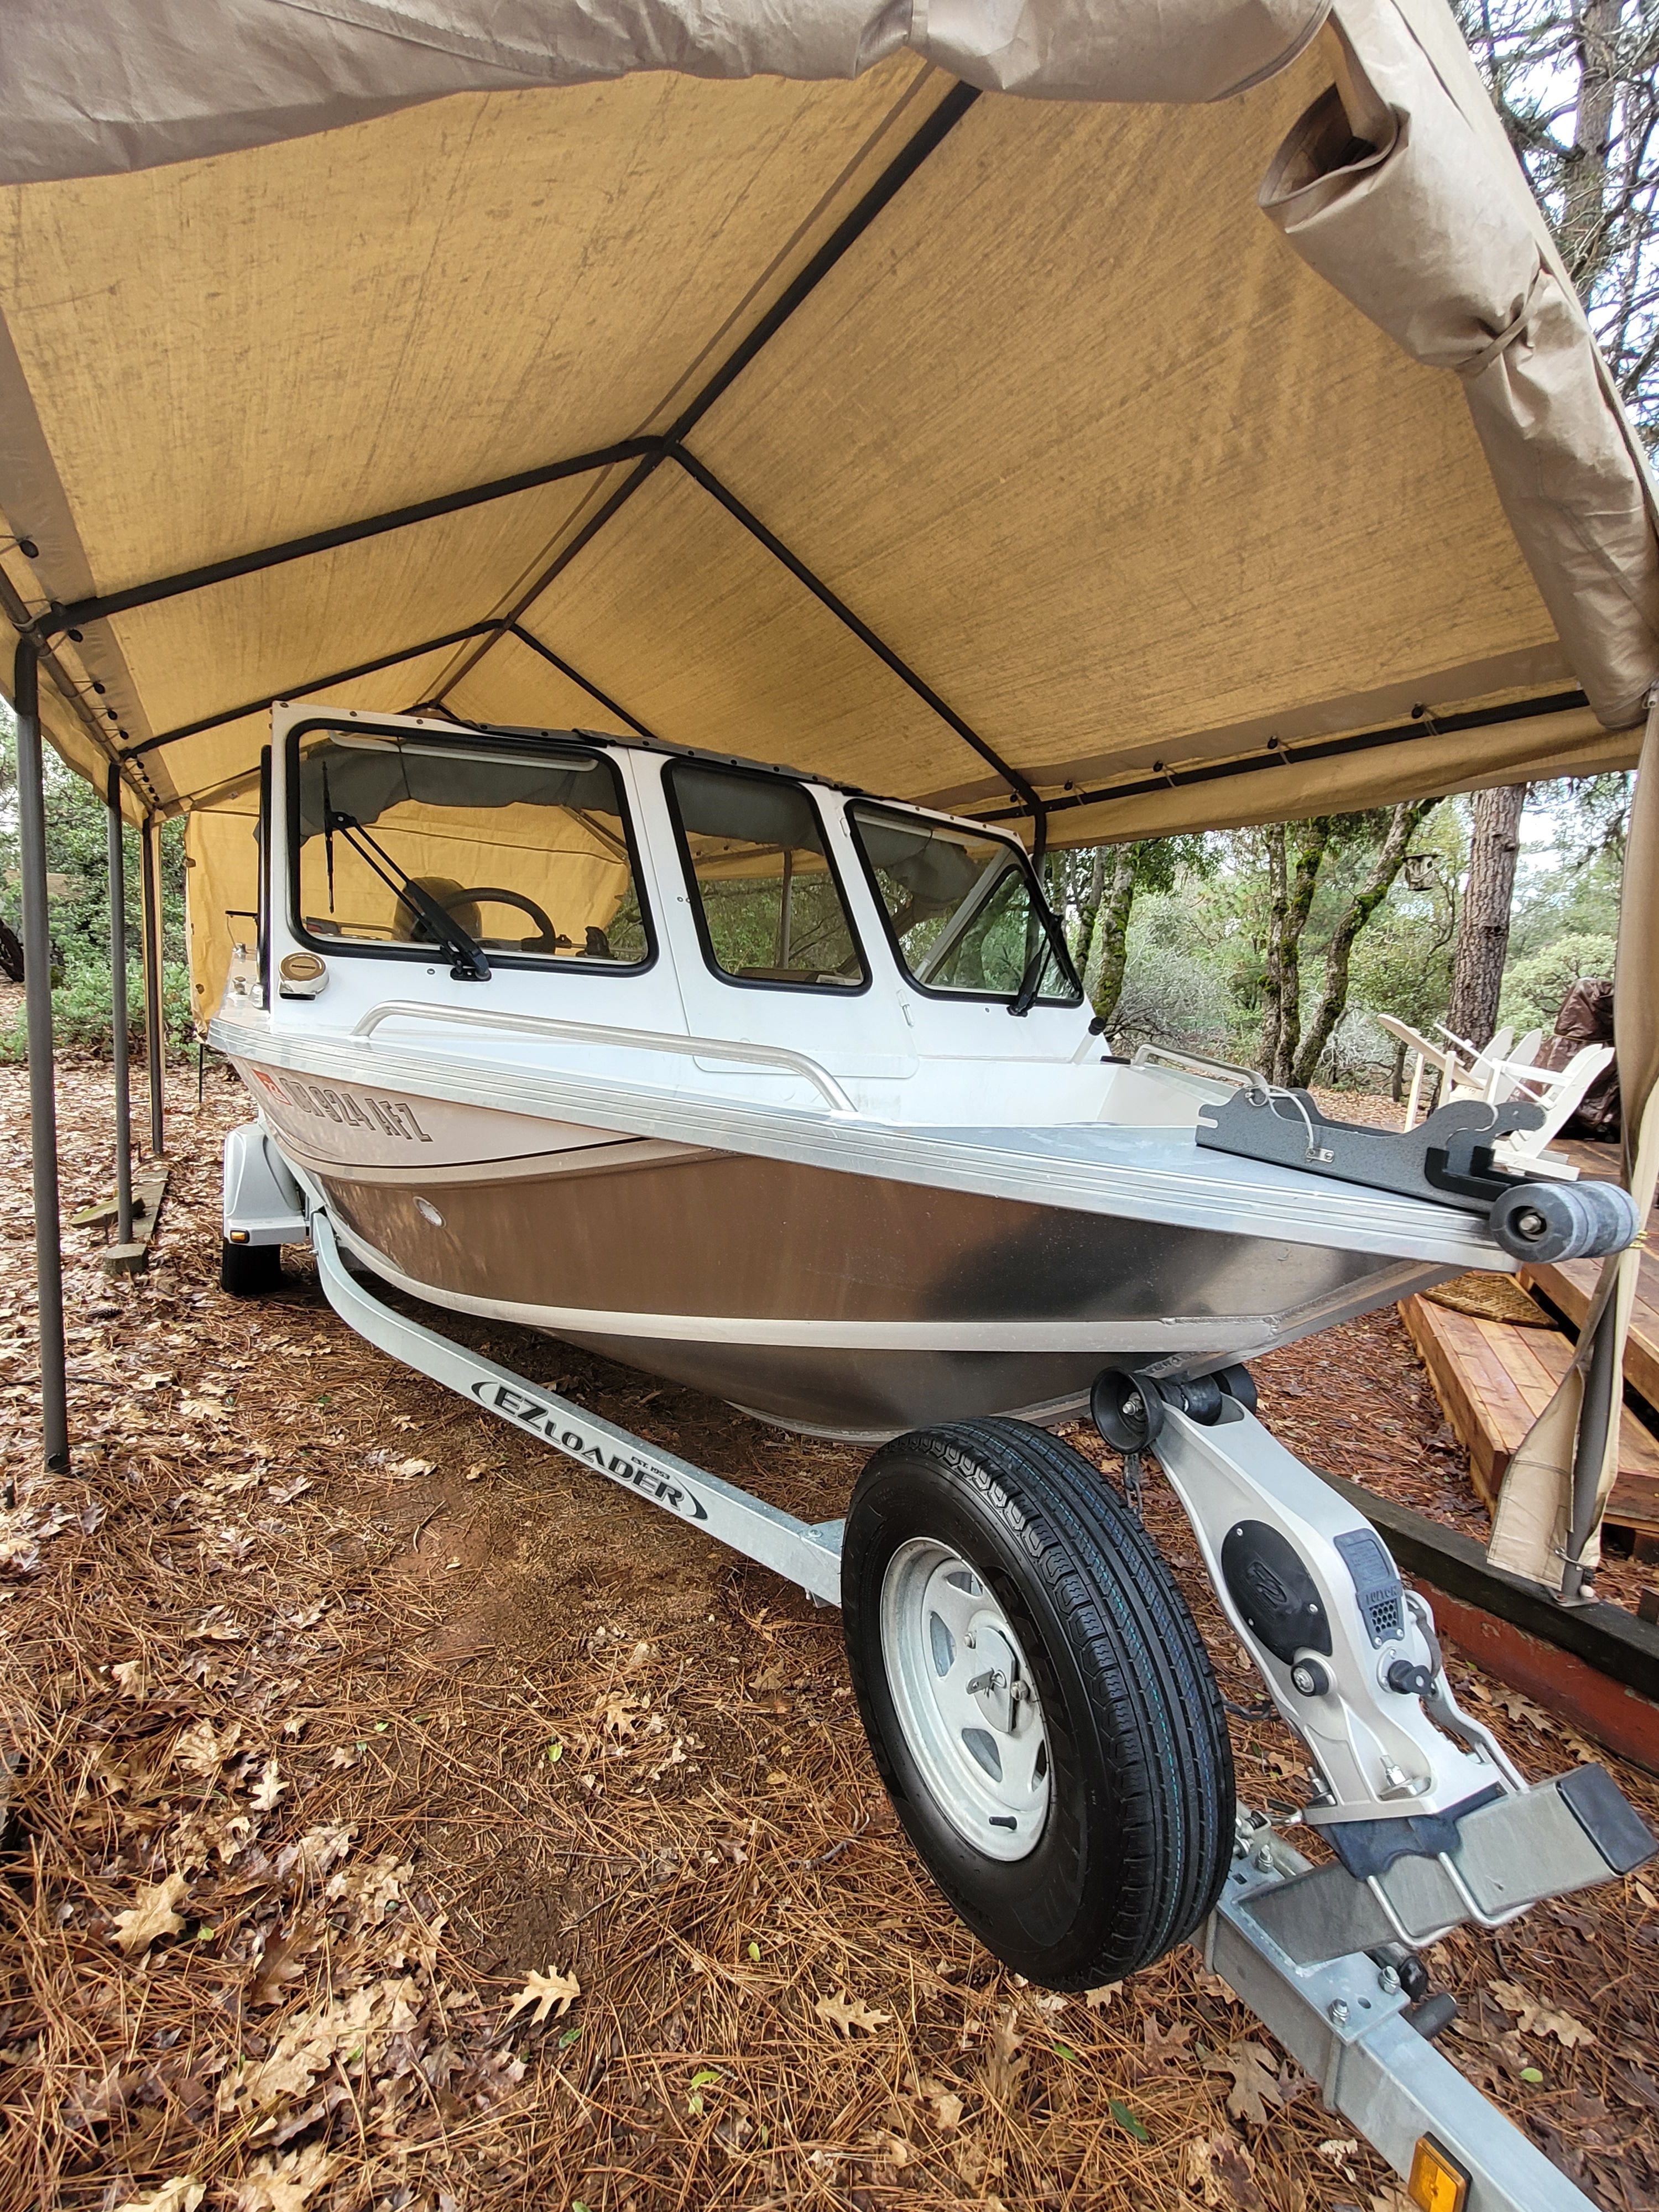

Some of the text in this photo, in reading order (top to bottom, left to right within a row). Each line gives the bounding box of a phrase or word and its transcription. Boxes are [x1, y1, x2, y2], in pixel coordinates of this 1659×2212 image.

[308, 1086, 376, 1131] 924
[364, 1098, 434, 1142] AFZ
[630, 1456, 670, 1480] EST. 1953
